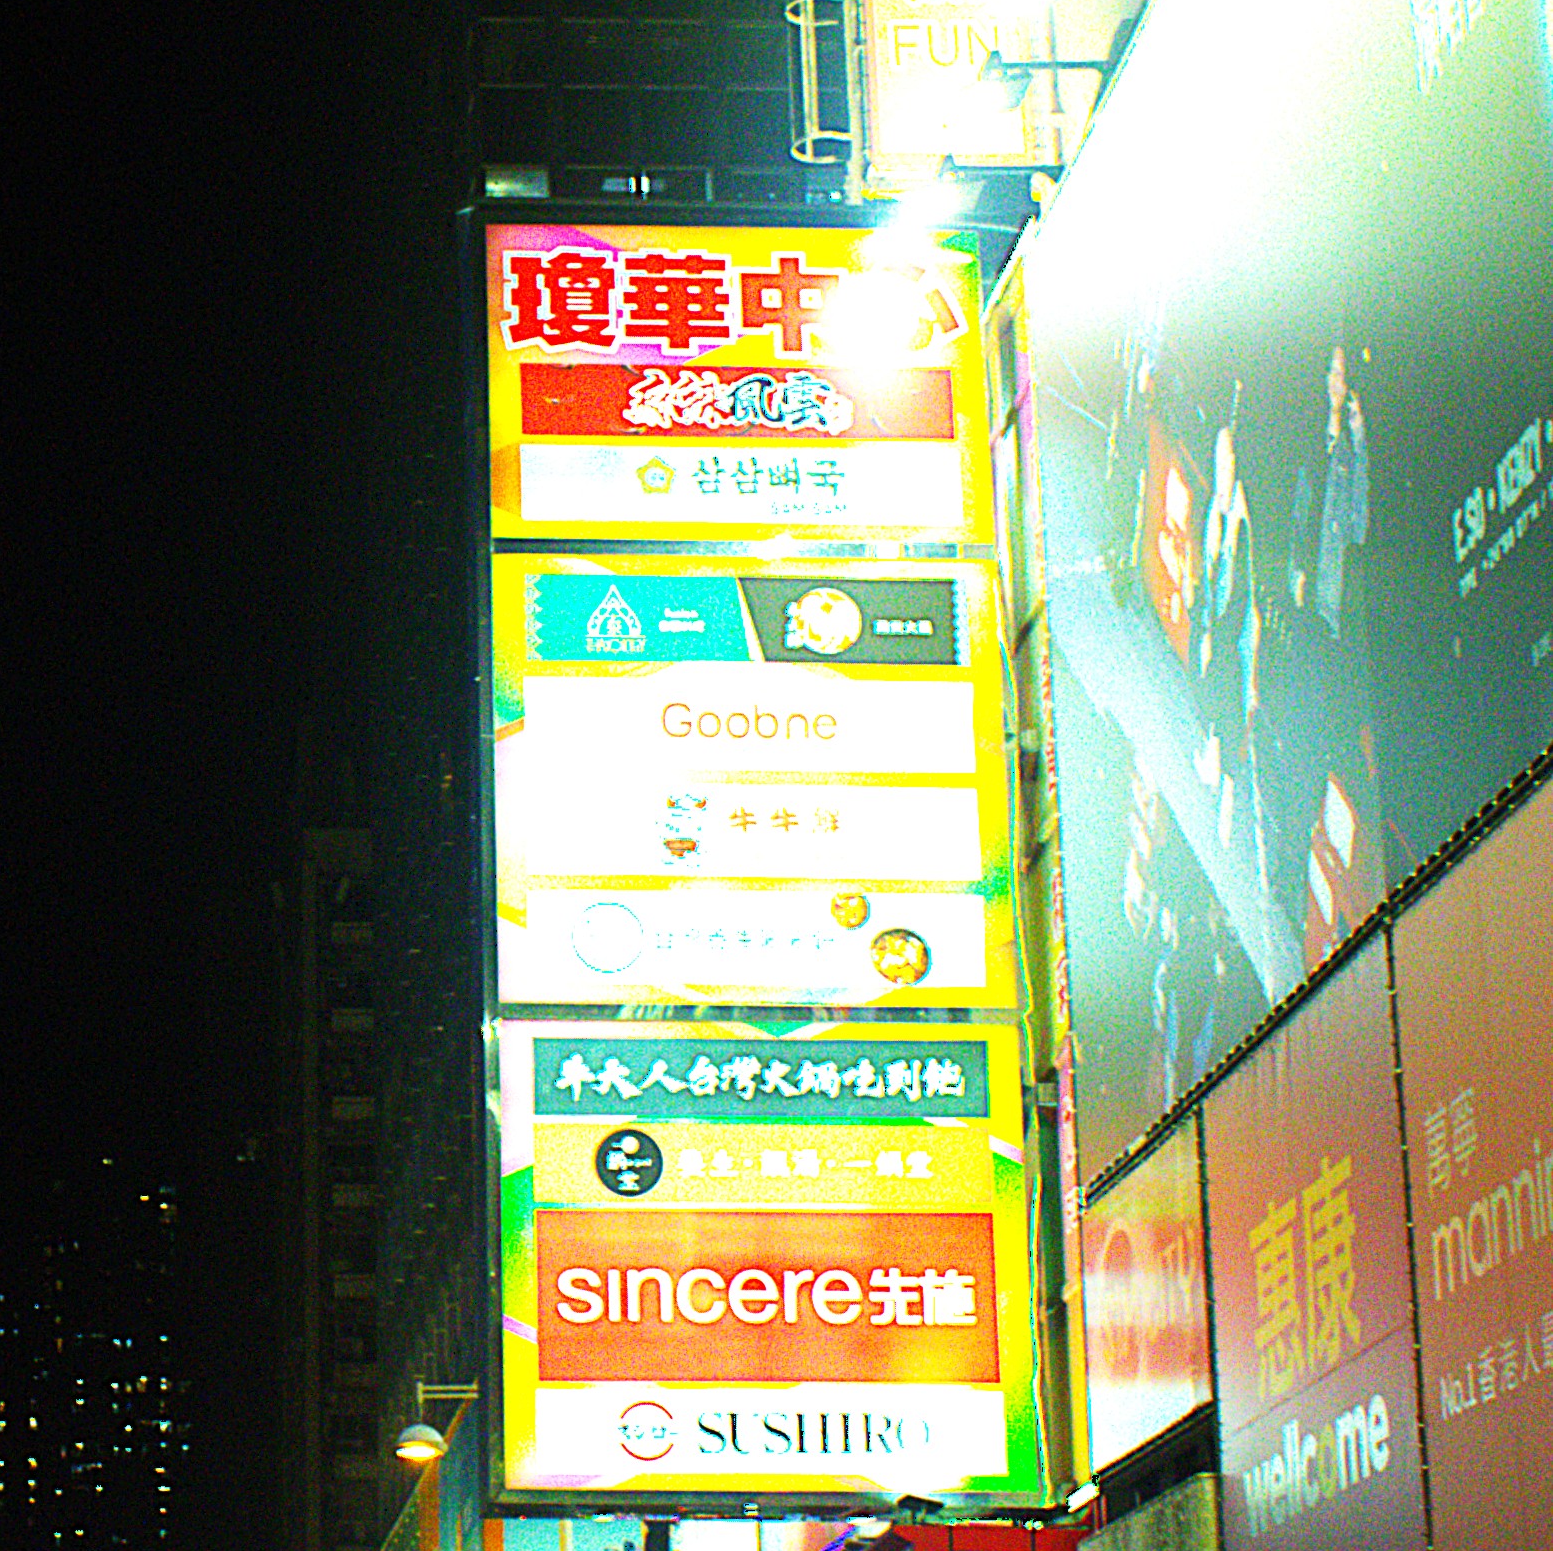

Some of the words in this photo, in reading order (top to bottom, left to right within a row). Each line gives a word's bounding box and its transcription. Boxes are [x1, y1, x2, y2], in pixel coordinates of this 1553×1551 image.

[503, 250, 963, 353] 瓊華中
[661, 702, 838, 740] Goobne
[556, 1267, 863, 1324] sincere
[868, 1267, 978, 1326] 先施
[697, 1412, 929, 1454] SUSHIRO
[1243, 1393, 1391, 1538] wellcome
